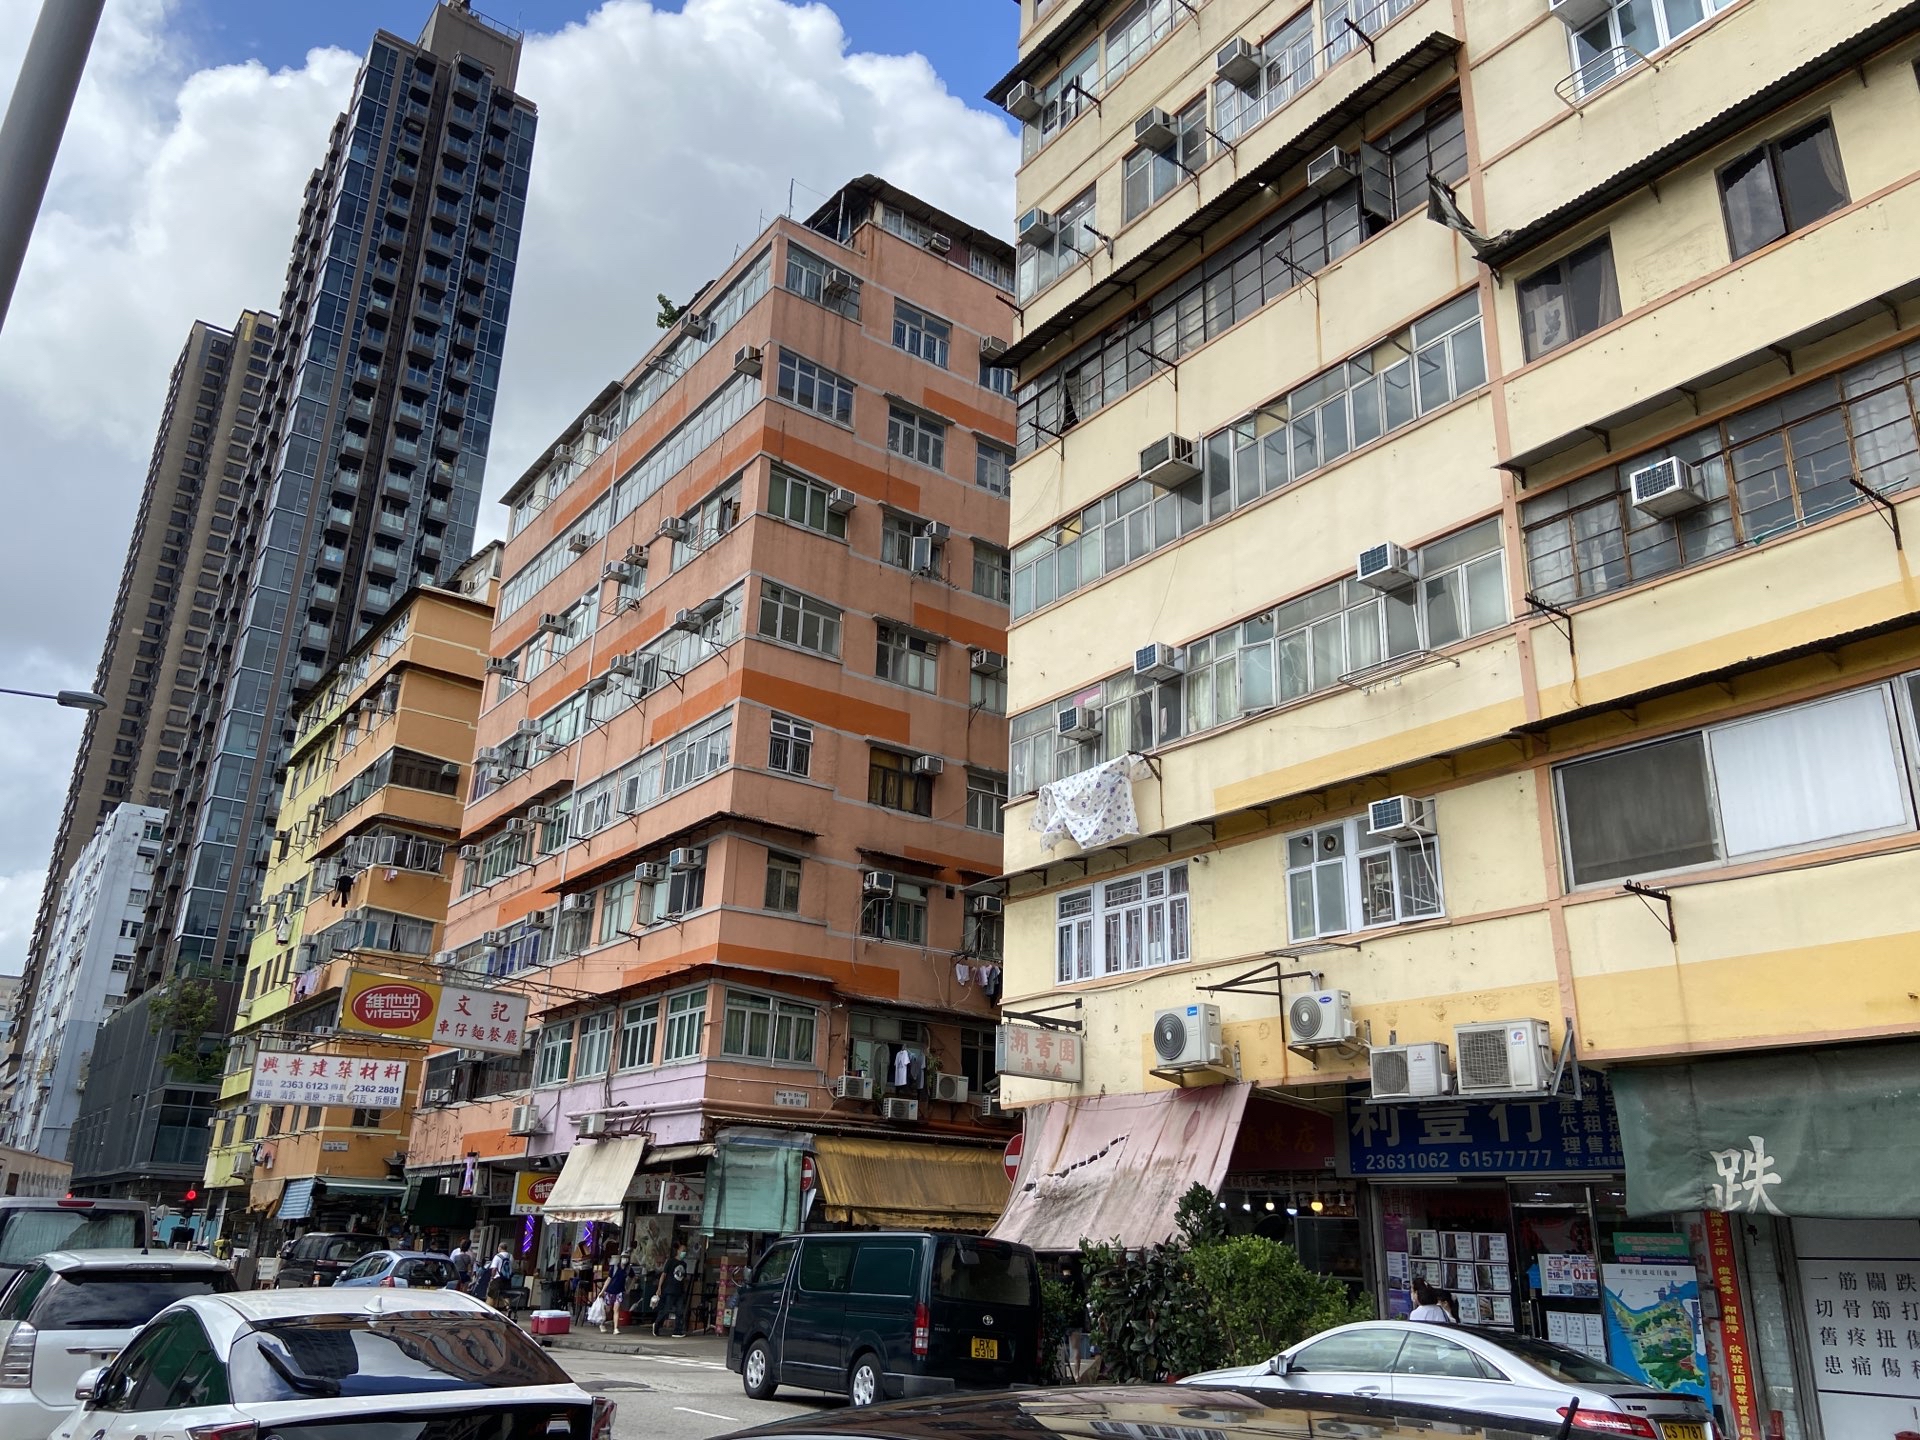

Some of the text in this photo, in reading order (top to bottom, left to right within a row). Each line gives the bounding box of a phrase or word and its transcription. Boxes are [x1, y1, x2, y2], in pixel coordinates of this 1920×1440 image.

[365, 993, 421, 1010] 維他奶
[454, 995, 511, 1023] 文記
[437, 1020, 518, 1046] 車仔麵餐廳
[1010, 1028, 1076, 1065] 潮香園
[259, 1056, 402, 1082] 興業建築材料
[280, 1079, 303, 1089] 2363
[305, 1081, 329, 1091] 6123
[354, 1084, 376, 1093] 2362
[378, 1085, 400, 1094] 2881
[1366, 1149, 1553, 1171] 23631062 61577777
[1709, 1135, 1789, 1217] 跌
[1810, 1276, 1844, 1376] 一切舊患
[1838, 1271, 1872, 1377] 筋骨疼痛
[1866, 1271, 1902, 1379] 關節扭傷
[974, 1348, 995, 1359] 5310
[1664, 1425, 1704, 1440] CS 7787
